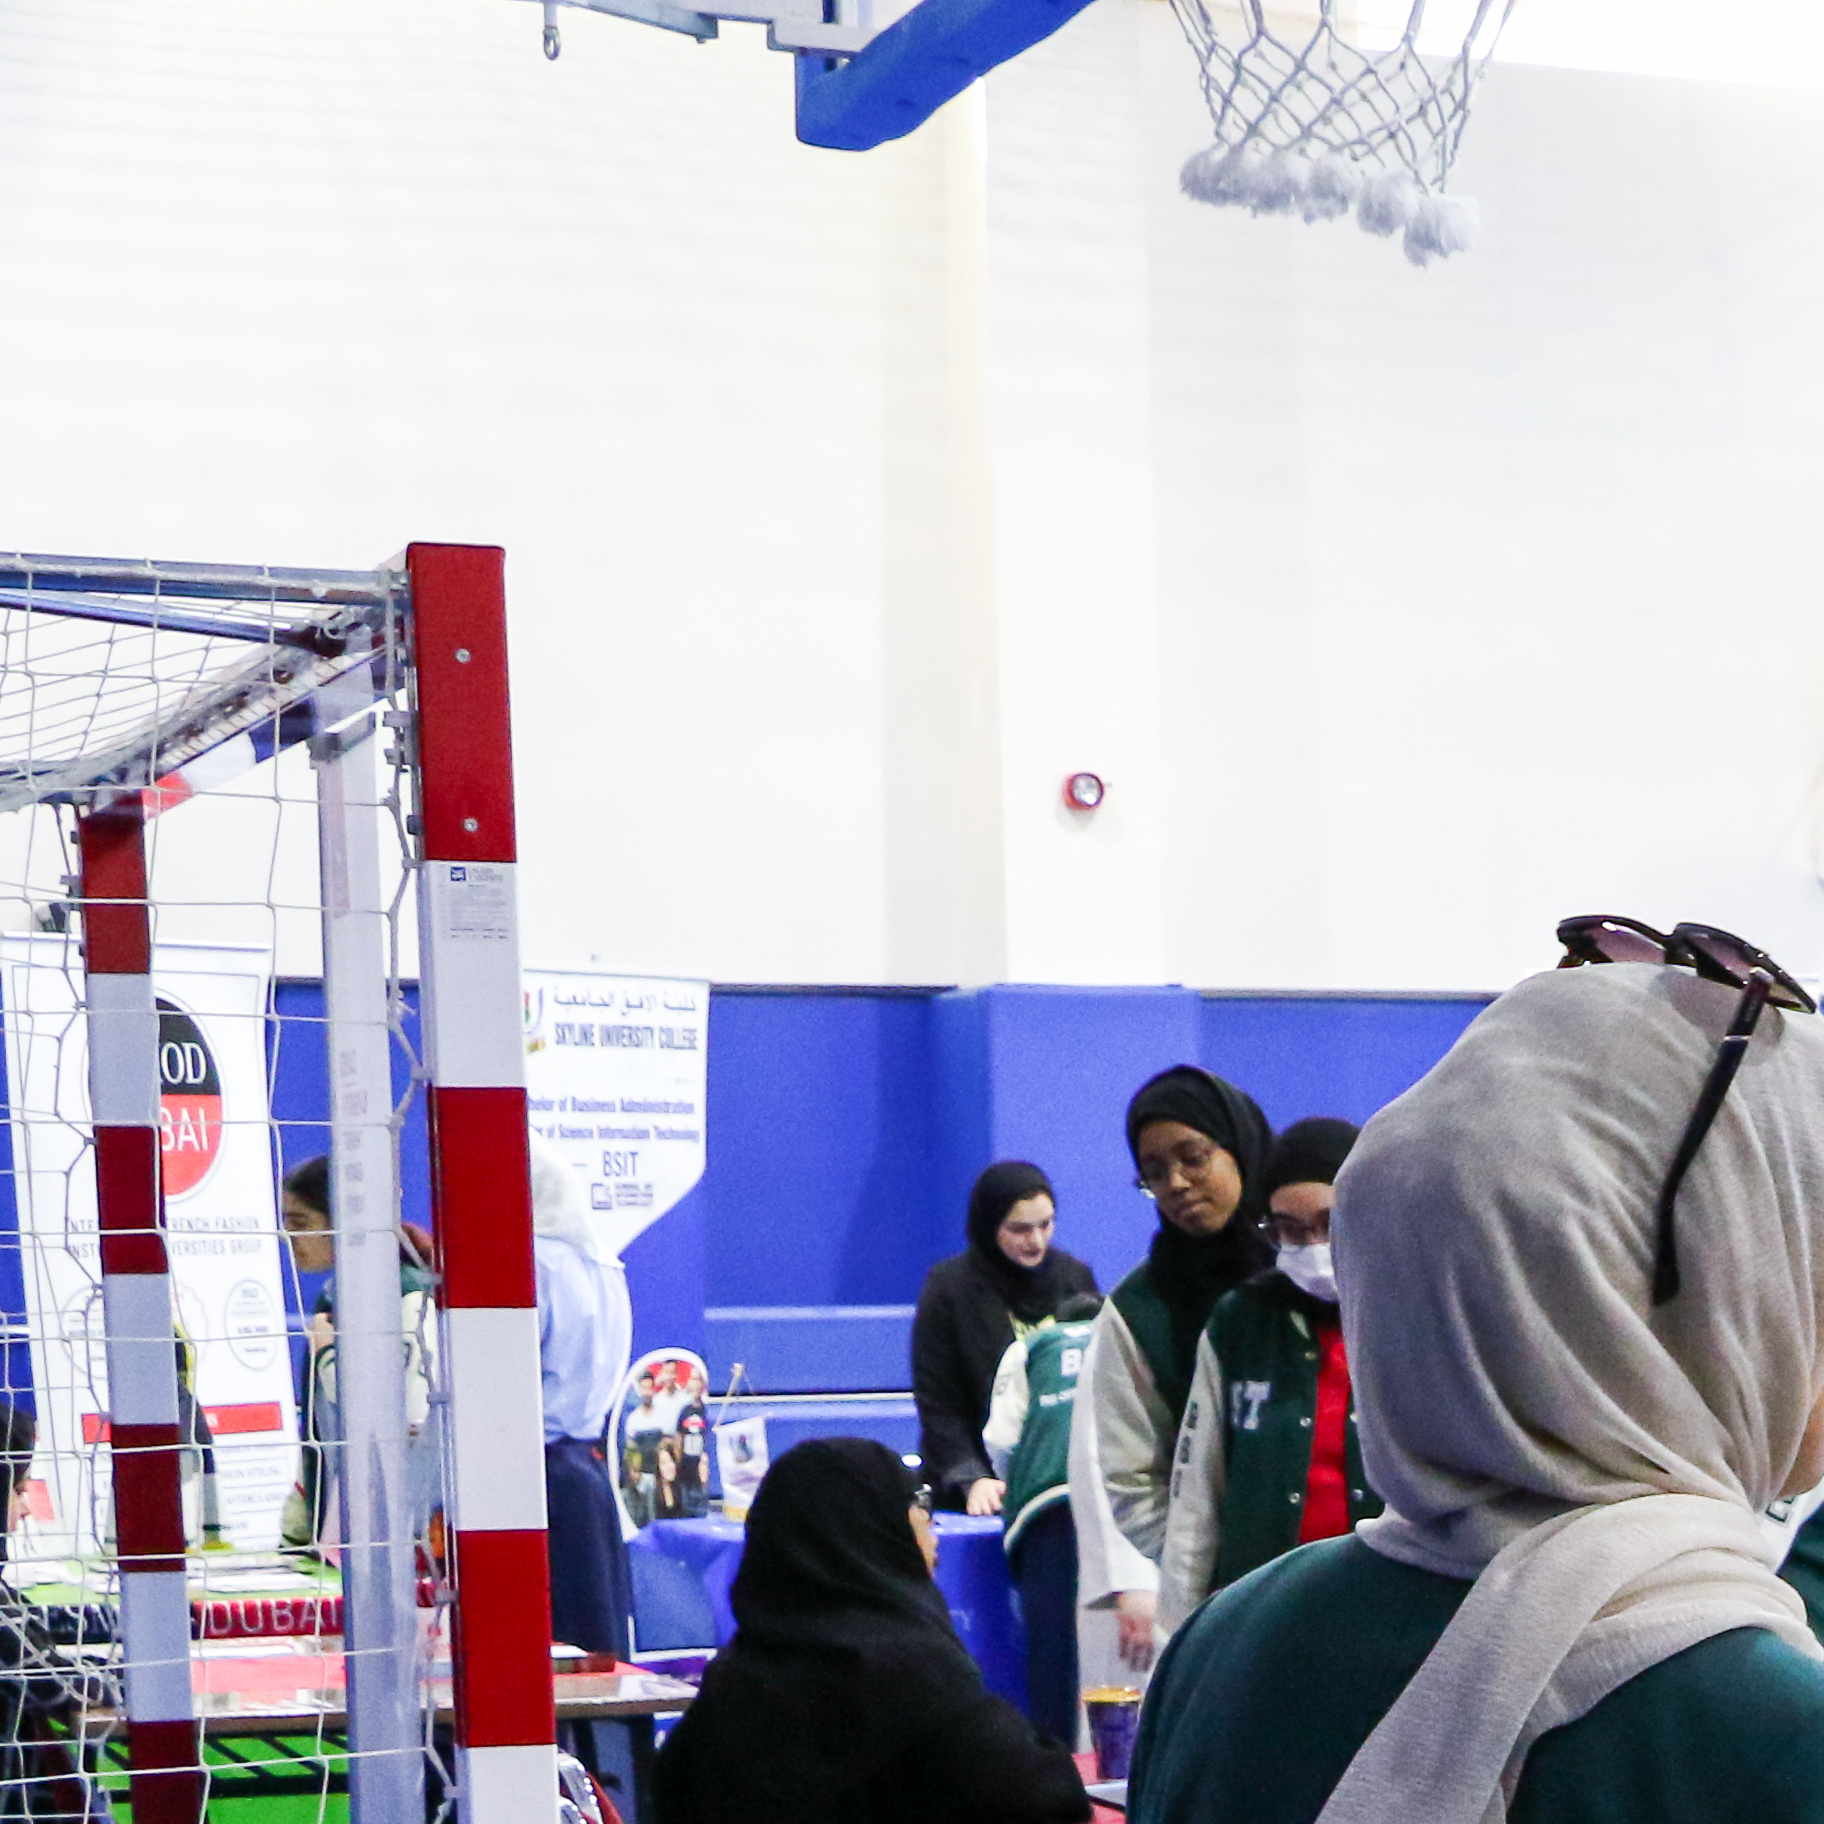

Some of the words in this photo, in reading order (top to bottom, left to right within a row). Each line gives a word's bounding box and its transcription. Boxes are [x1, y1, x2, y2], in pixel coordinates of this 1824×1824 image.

[555, 1022, 595, 1047] SKYLINE
[599, 1024, 654, 1048] UNIVERSITY
[659, 1025, 698, 1050] COLLEGE
[160, 1041, 207, 1084] OD
[603, 1151, 639, 1176] BSIT
